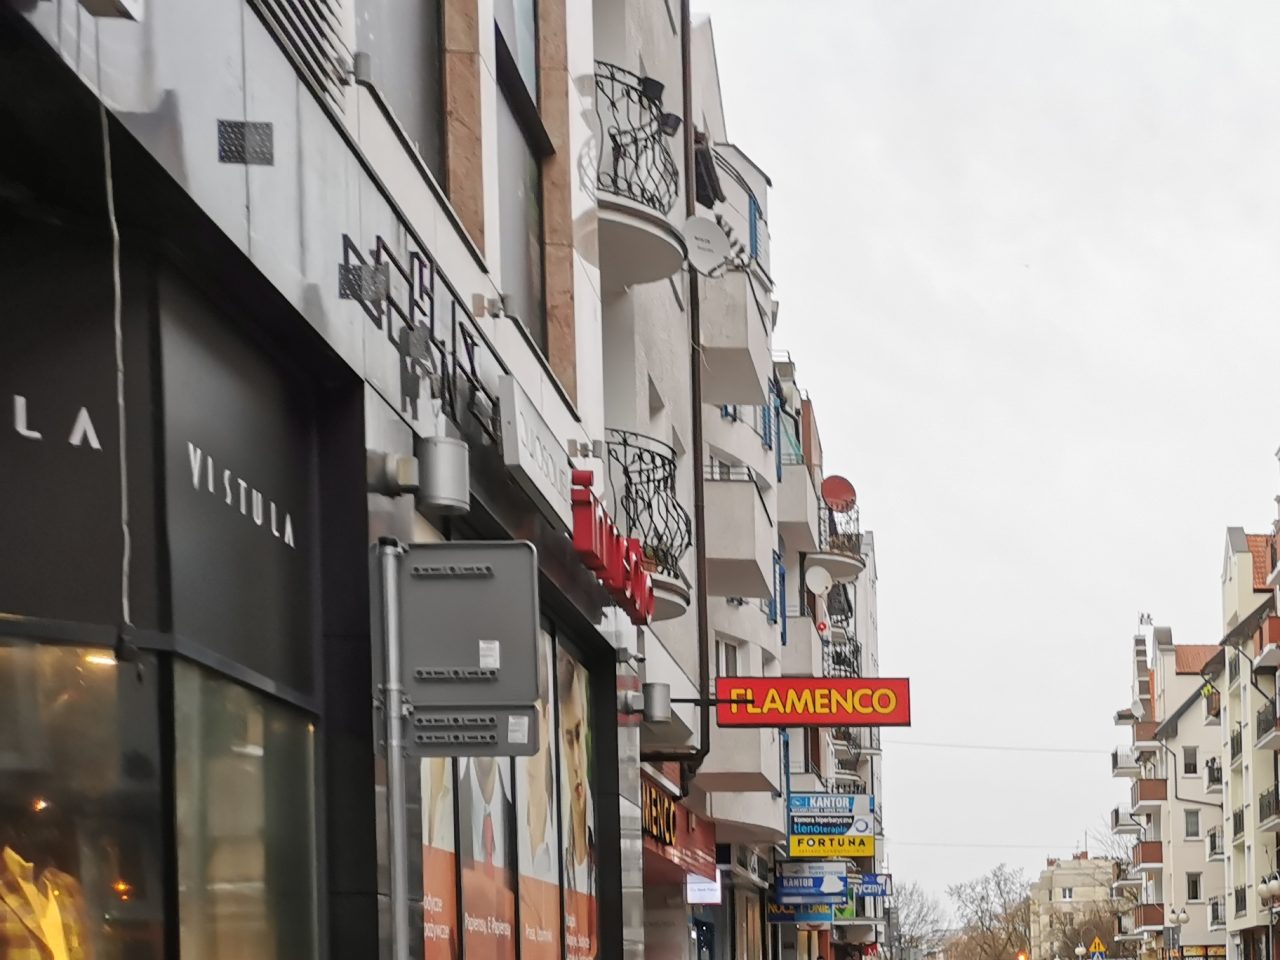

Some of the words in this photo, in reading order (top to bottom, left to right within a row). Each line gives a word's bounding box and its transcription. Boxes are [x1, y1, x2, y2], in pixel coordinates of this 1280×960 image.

[187, 441, 296, 549] VISTULA
[730, 688, 897, 715] FLAMENCO
[809, 796, 849, 807] KANTOR
[797, 838, 866, 848] FORTUNA
[783, 878, 813, 887] KANTOR
